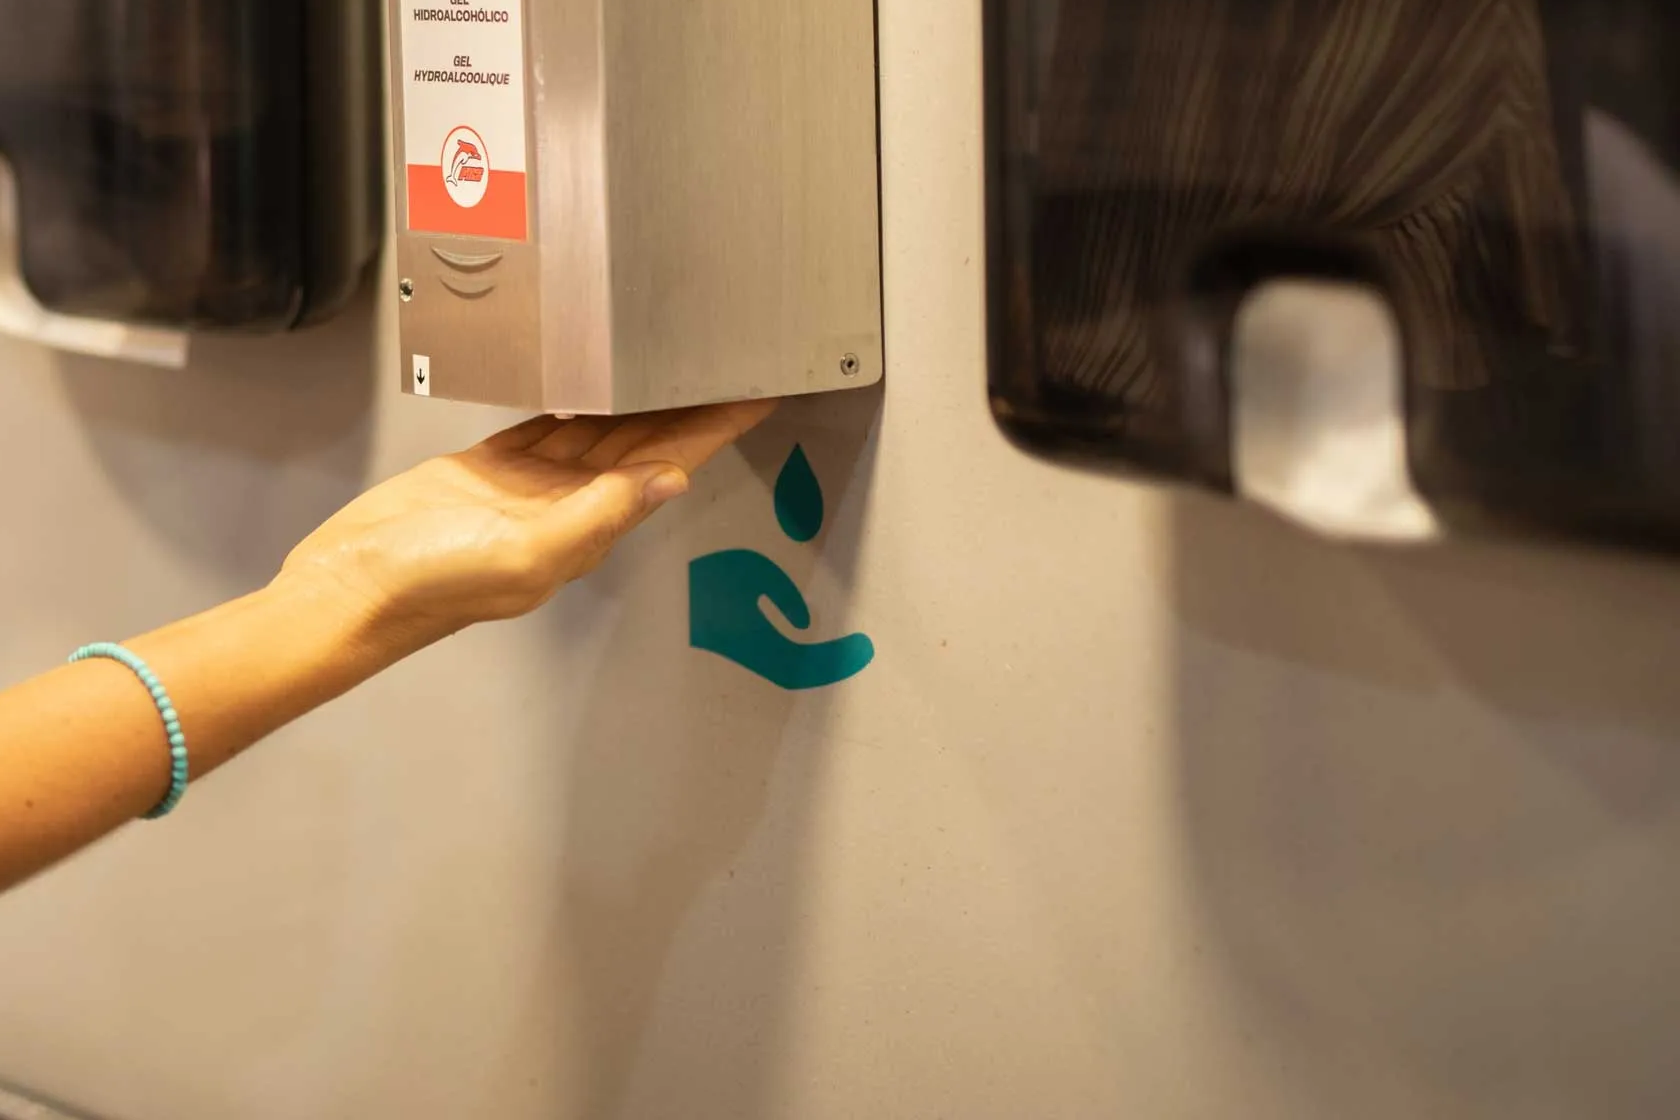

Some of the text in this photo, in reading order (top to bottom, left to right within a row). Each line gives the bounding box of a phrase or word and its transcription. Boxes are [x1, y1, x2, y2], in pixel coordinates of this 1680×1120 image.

[413, 8, 509, 22] HIDROALCOHÓLICO
[453, 55, 472, 67] GEL
[414, 70, 510, 85] HYDROALCOOLIQUE
